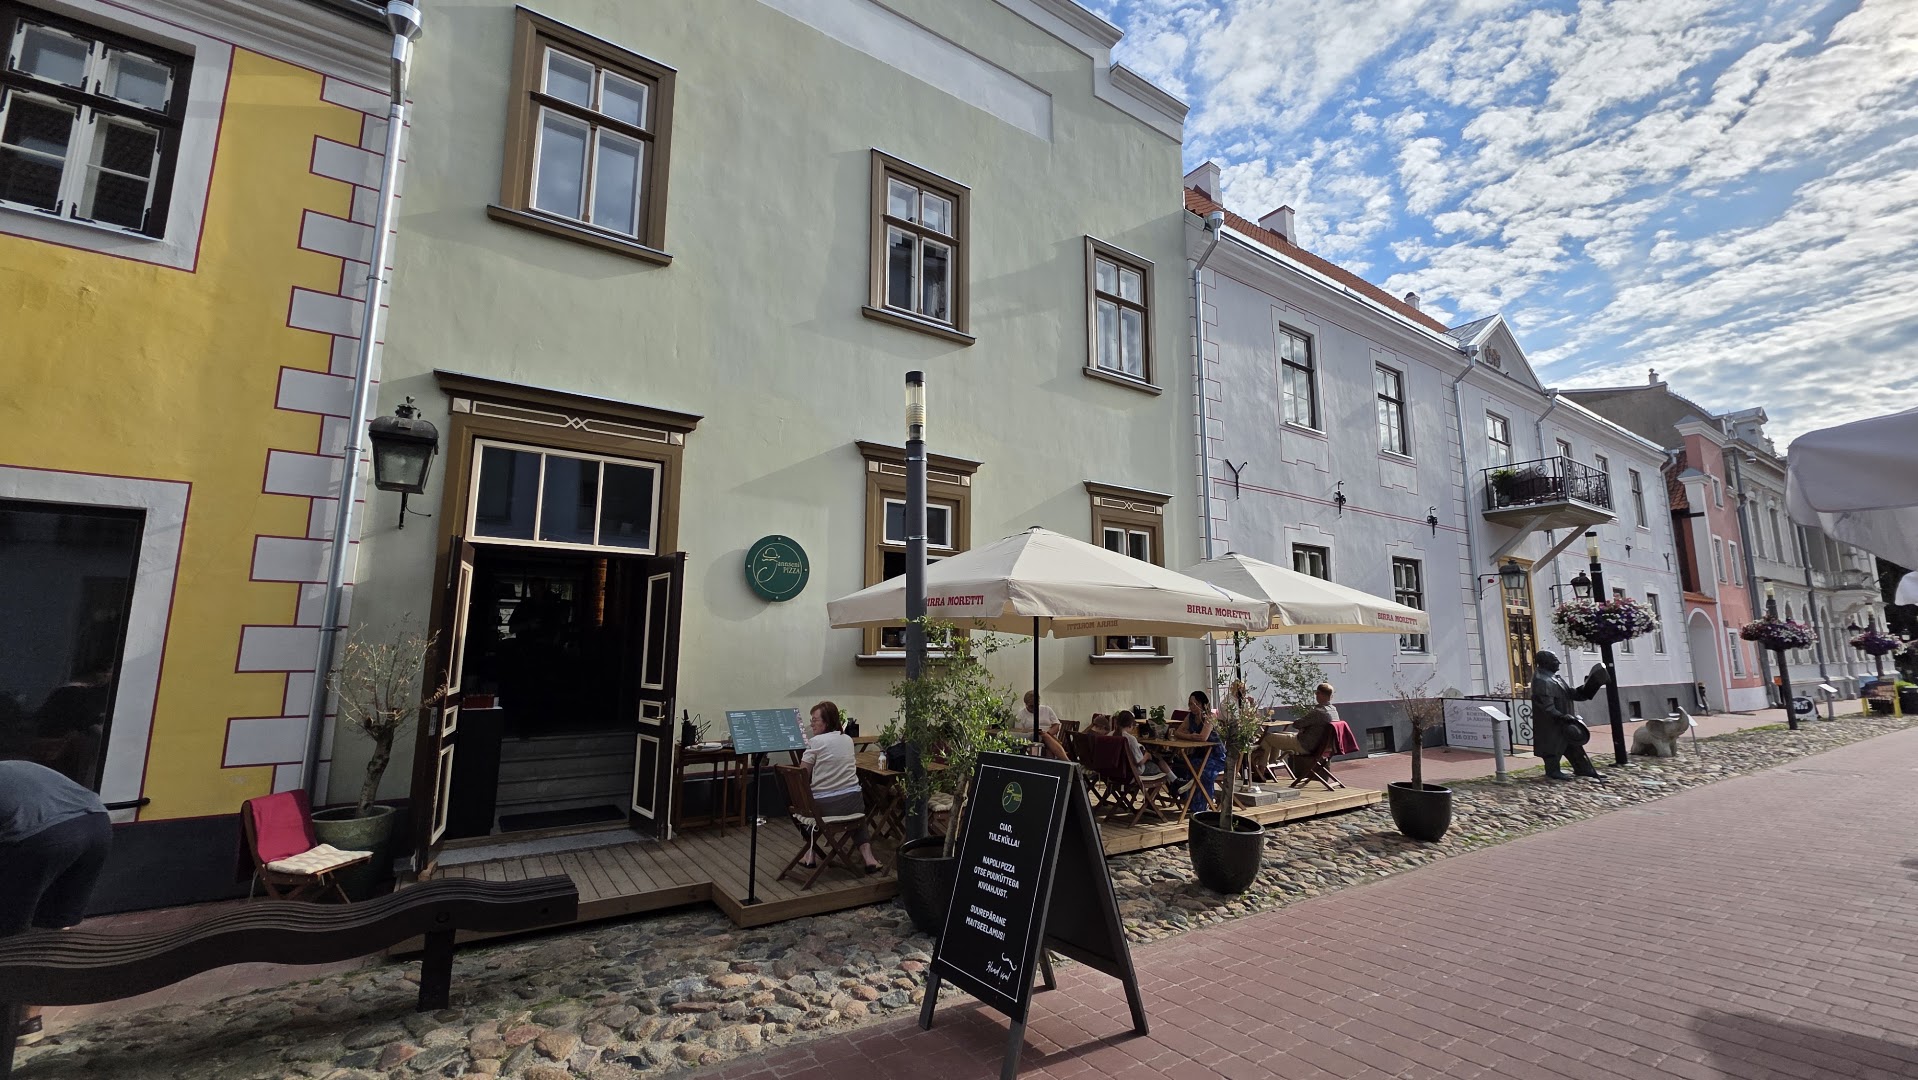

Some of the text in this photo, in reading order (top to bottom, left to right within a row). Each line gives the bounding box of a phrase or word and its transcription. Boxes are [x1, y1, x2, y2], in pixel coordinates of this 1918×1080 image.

[783, 566, 800, 574] PIZZA
[926, 595, 984, 607] IRRA MORETTI
[1186, 604, 1252, 620] BIRRA MORETTI
[1377, 612, 1418, 626] BIRRA MORETTI
[988, 831, 1020, 848] TULE KÜLLA!
[982, 855, 1015, 874] NAPOLI PIZZA
[973, 865, 1020, 889] OTSE PUUKÜTTEGA
[969, 904, 1007, 927] SUUREPÄRANE
[965, 915, 1006, 941] MAITSEELAMUS!
